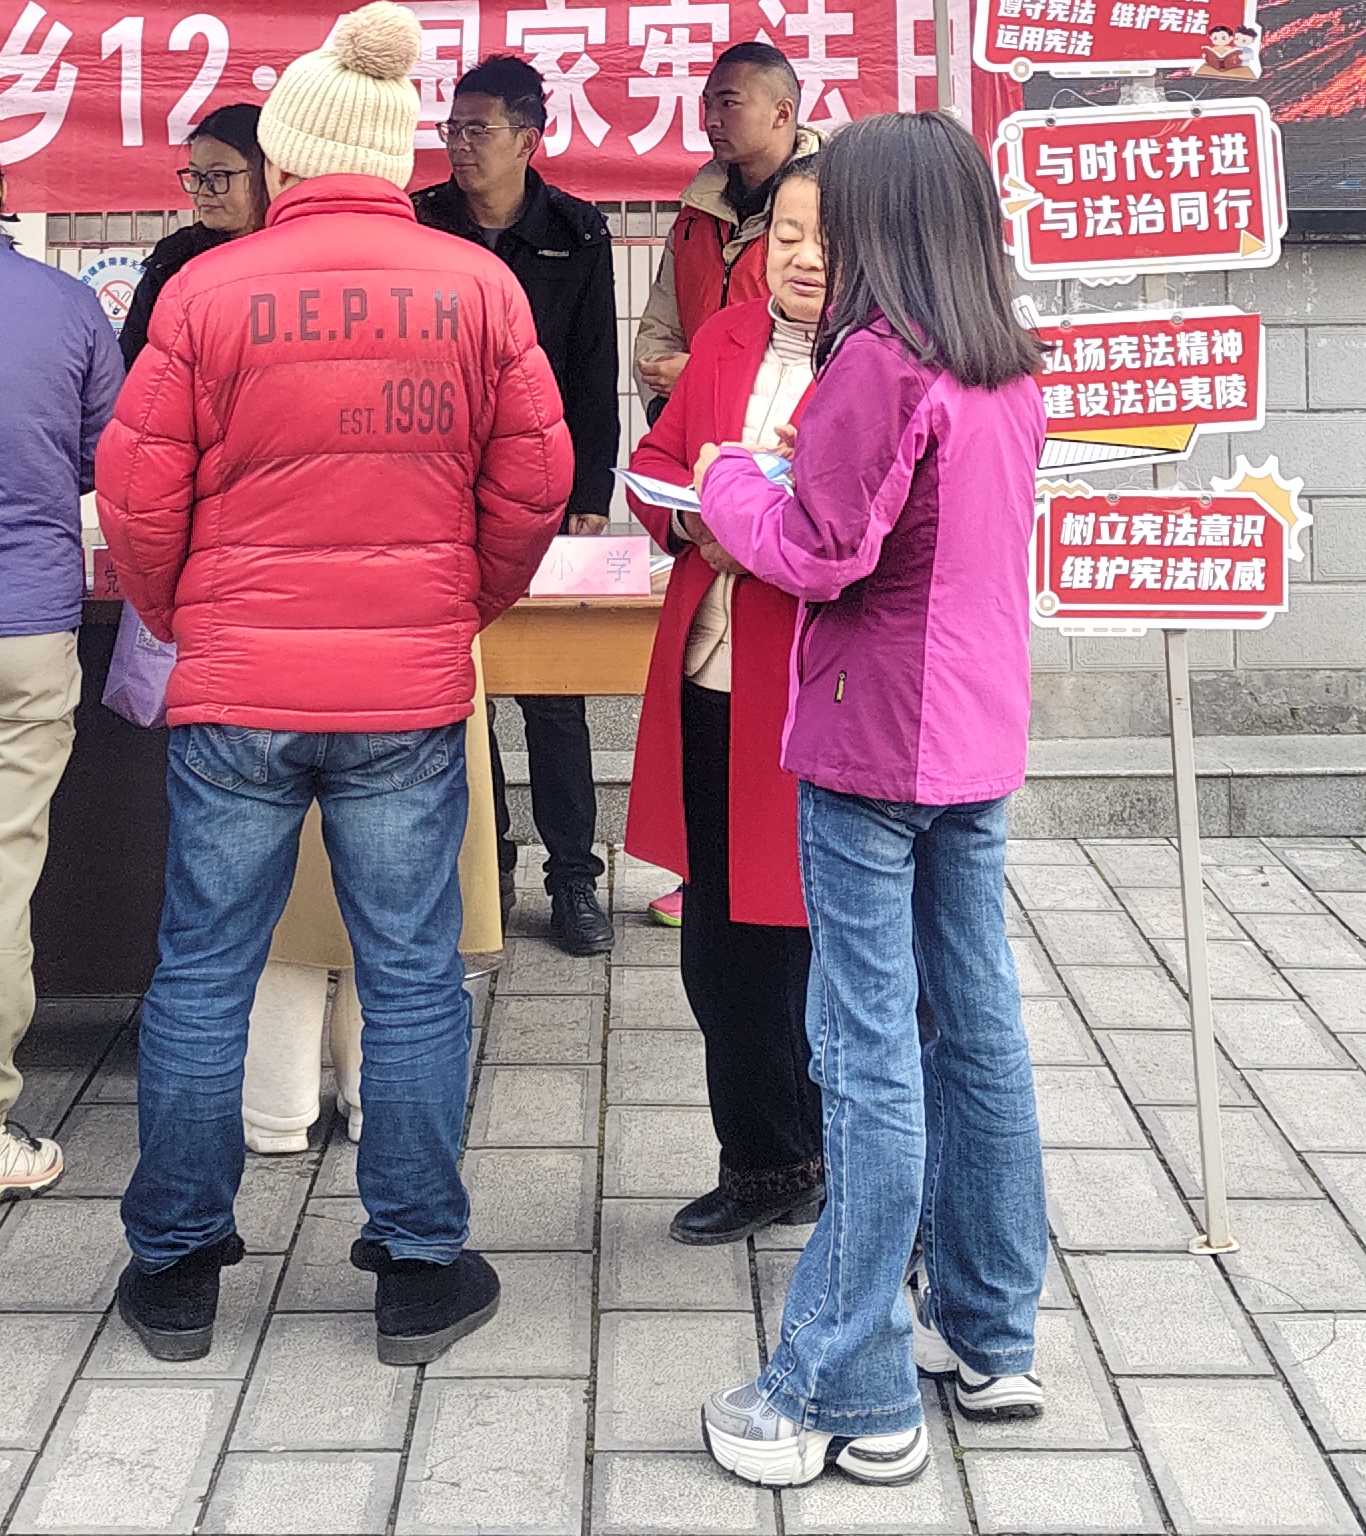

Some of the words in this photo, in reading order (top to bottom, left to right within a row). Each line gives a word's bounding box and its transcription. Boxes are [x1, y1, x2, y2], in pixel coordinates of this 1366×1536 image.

[995, 24, 1094, 57] 运用宪法
[1110, 2, 1210, 35] 维护宪法
[1036, 132, 1250, 185] 与时代并进
[1040, 188, 1253, 239] 与法治同行
[250, 287, 458, 345] D.E.P.T.H
[1041, 329, 1243, 375] 弘扬宪法精神
[381, 378, 455, 435] 1996
[1042, 374, 1248, 419] 建设法治夷陵
[1060, 512, 1265, 548] 树立宪法意识
[1060, 556, 1266, 591] 维护宪法权威
